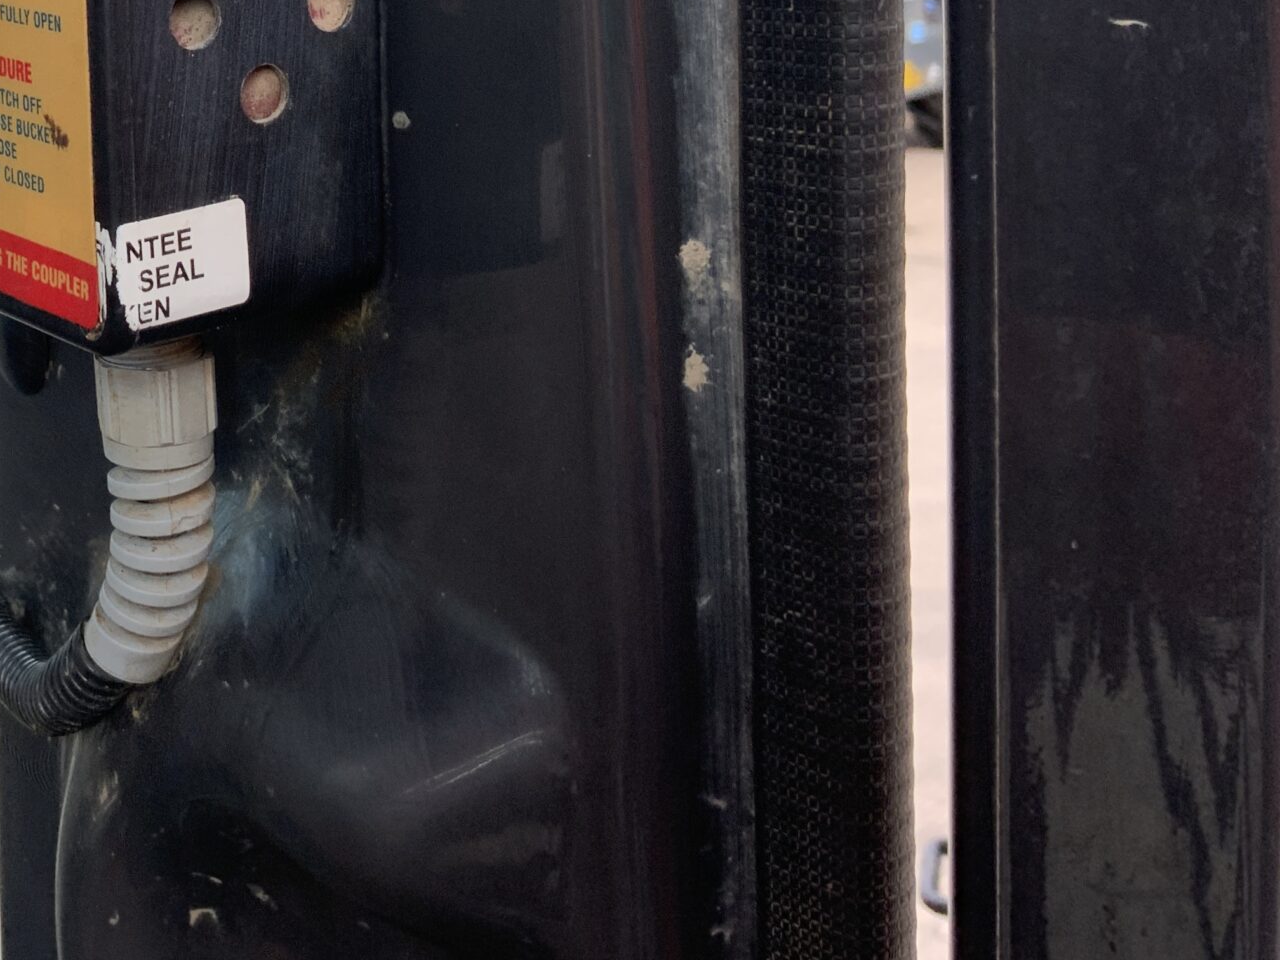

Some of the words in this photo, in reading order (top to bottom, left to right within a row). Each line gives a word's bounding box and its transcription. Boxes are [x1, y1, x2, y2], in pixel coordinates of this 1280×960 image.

[0, 4, 30, 26] FULLY
[33, 11, 61, 32] OPEN
[22, 94, 42, 114] OFF
[4, 165, 45, 193] CLOSED
[125, 227, 193, 263] NTEE
[6, 250, 28, 276] THE
[31, 260, 89, 301] COUPLER
[140, 258, 205, 293] SEAL
